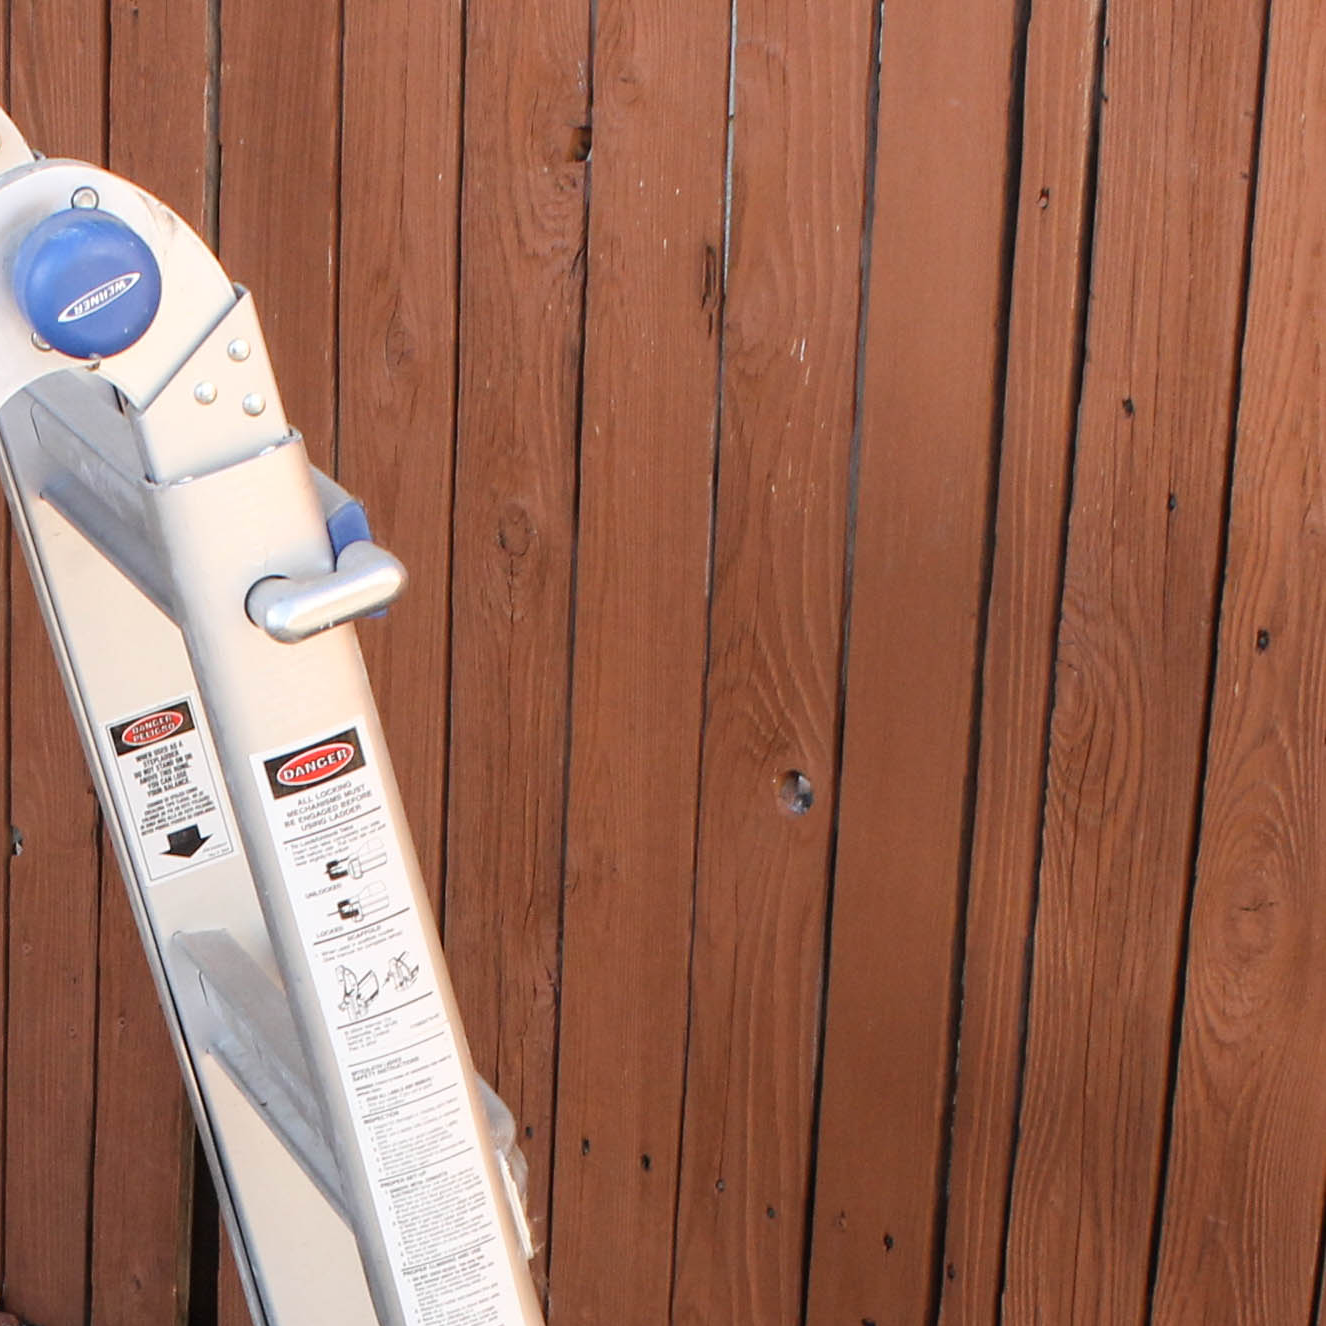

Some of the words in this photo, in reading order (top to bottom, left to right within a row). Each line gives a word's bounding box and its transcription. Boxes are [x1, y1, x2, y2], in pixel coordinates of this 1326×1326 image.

[73, 278, 127, 316] WERNER
[131, 715, 170, 733] DANGER
[133, 723, 174, 741] PELIGRO
[136, 752, 151, 761] WHEN
[154, 746, 167, 755] USED
[156, 760, 173, 770] STAND
[283, 749, 347, 780] DANGER
[161, 776, 171, 784] CAN
[173, 771, 186, 779] LOSE
[148, 788, 161, 796] YOUR
[287, 794, 341, 818] MECHANISMS
[343, 784, 364, 795] MUST
[297, 795, 312, 805] ALL
[315, 781, 351, 798] LOCKING
[285, 819, 293, 827] BE
[298, 804, 338, 822] ENGAGED
[340, 790, 371, 805] BEFORE
[301, 818, 325, 830] USING
[329, 805, 361, 820] LADDER
